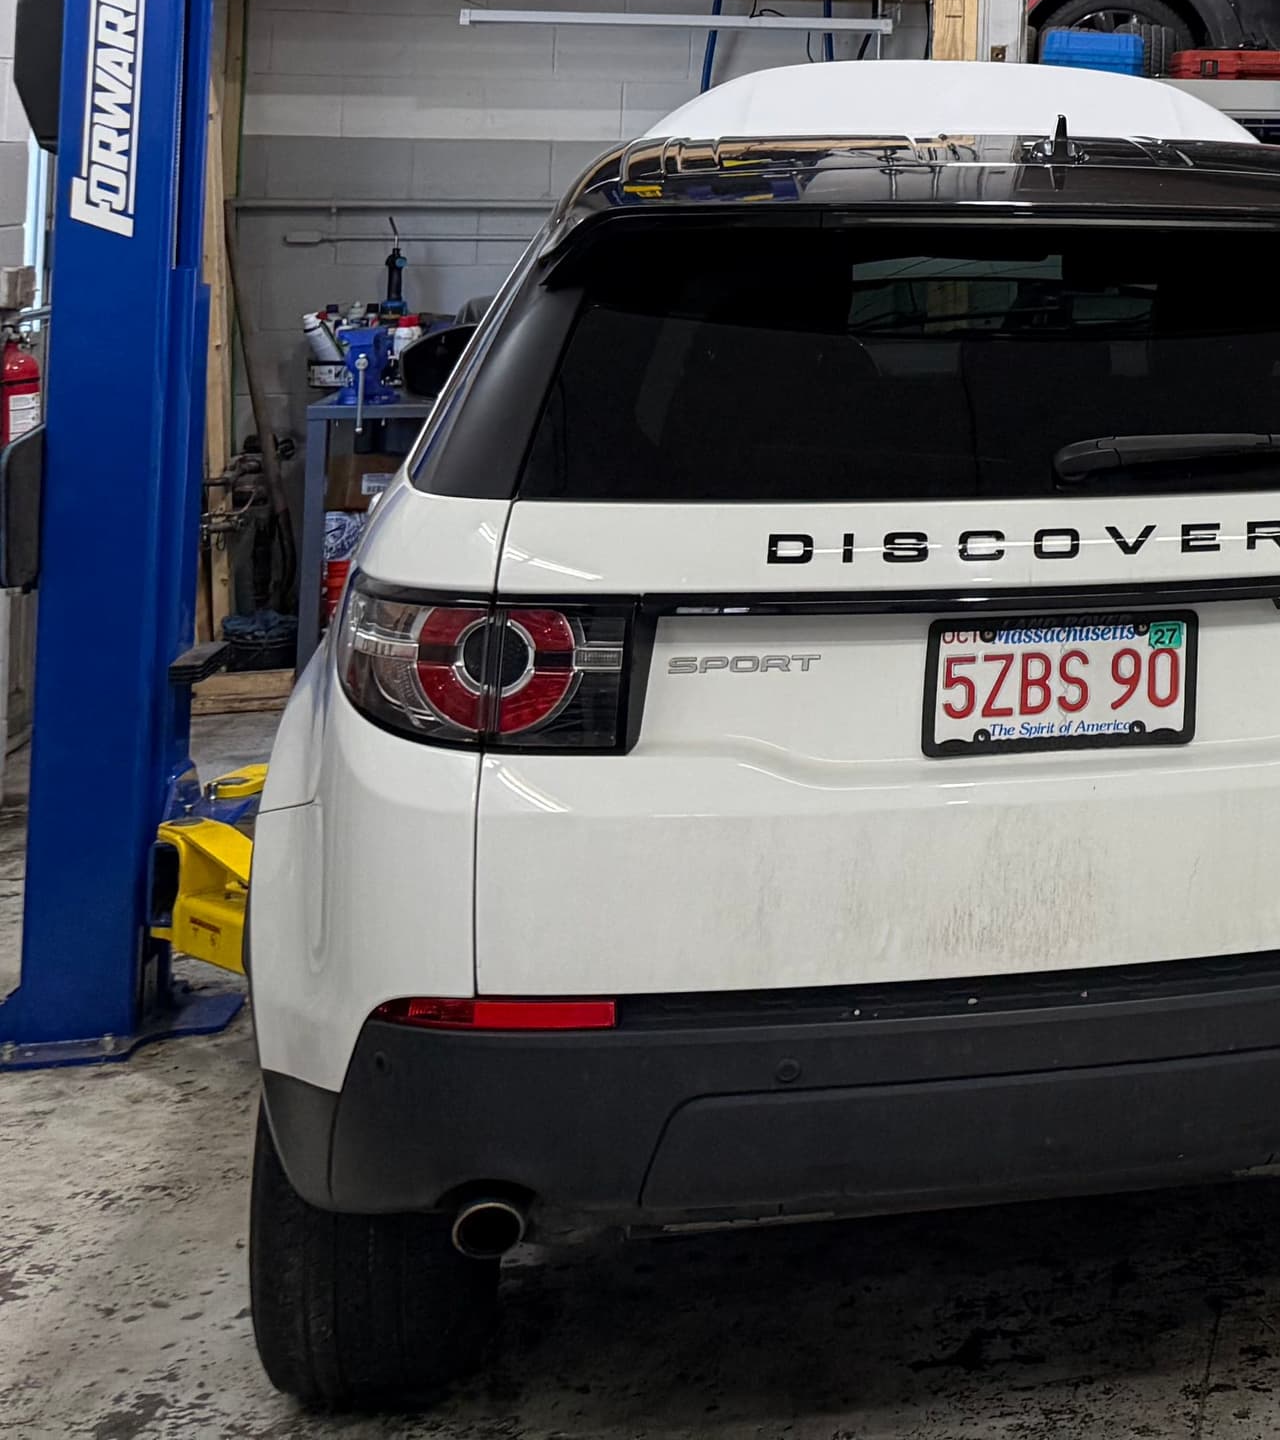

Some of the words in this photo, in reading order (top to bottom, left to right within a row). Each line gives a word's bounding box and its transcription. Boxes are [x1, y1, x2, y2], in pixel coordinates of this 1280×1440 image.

[992, 624, 1136, 645] Massachusetts
[1154, 628, 1177, 645] 27
[668, 654, 821, 674] SPORT
[942, 650, 1090, 719] 5ZBS
[1110, 648, 1180, 710] 90
[990, 723, 1015, 737] The
[1019, 722, 1055, 737] Spirit
[1058, 720, 1072, 734] of
